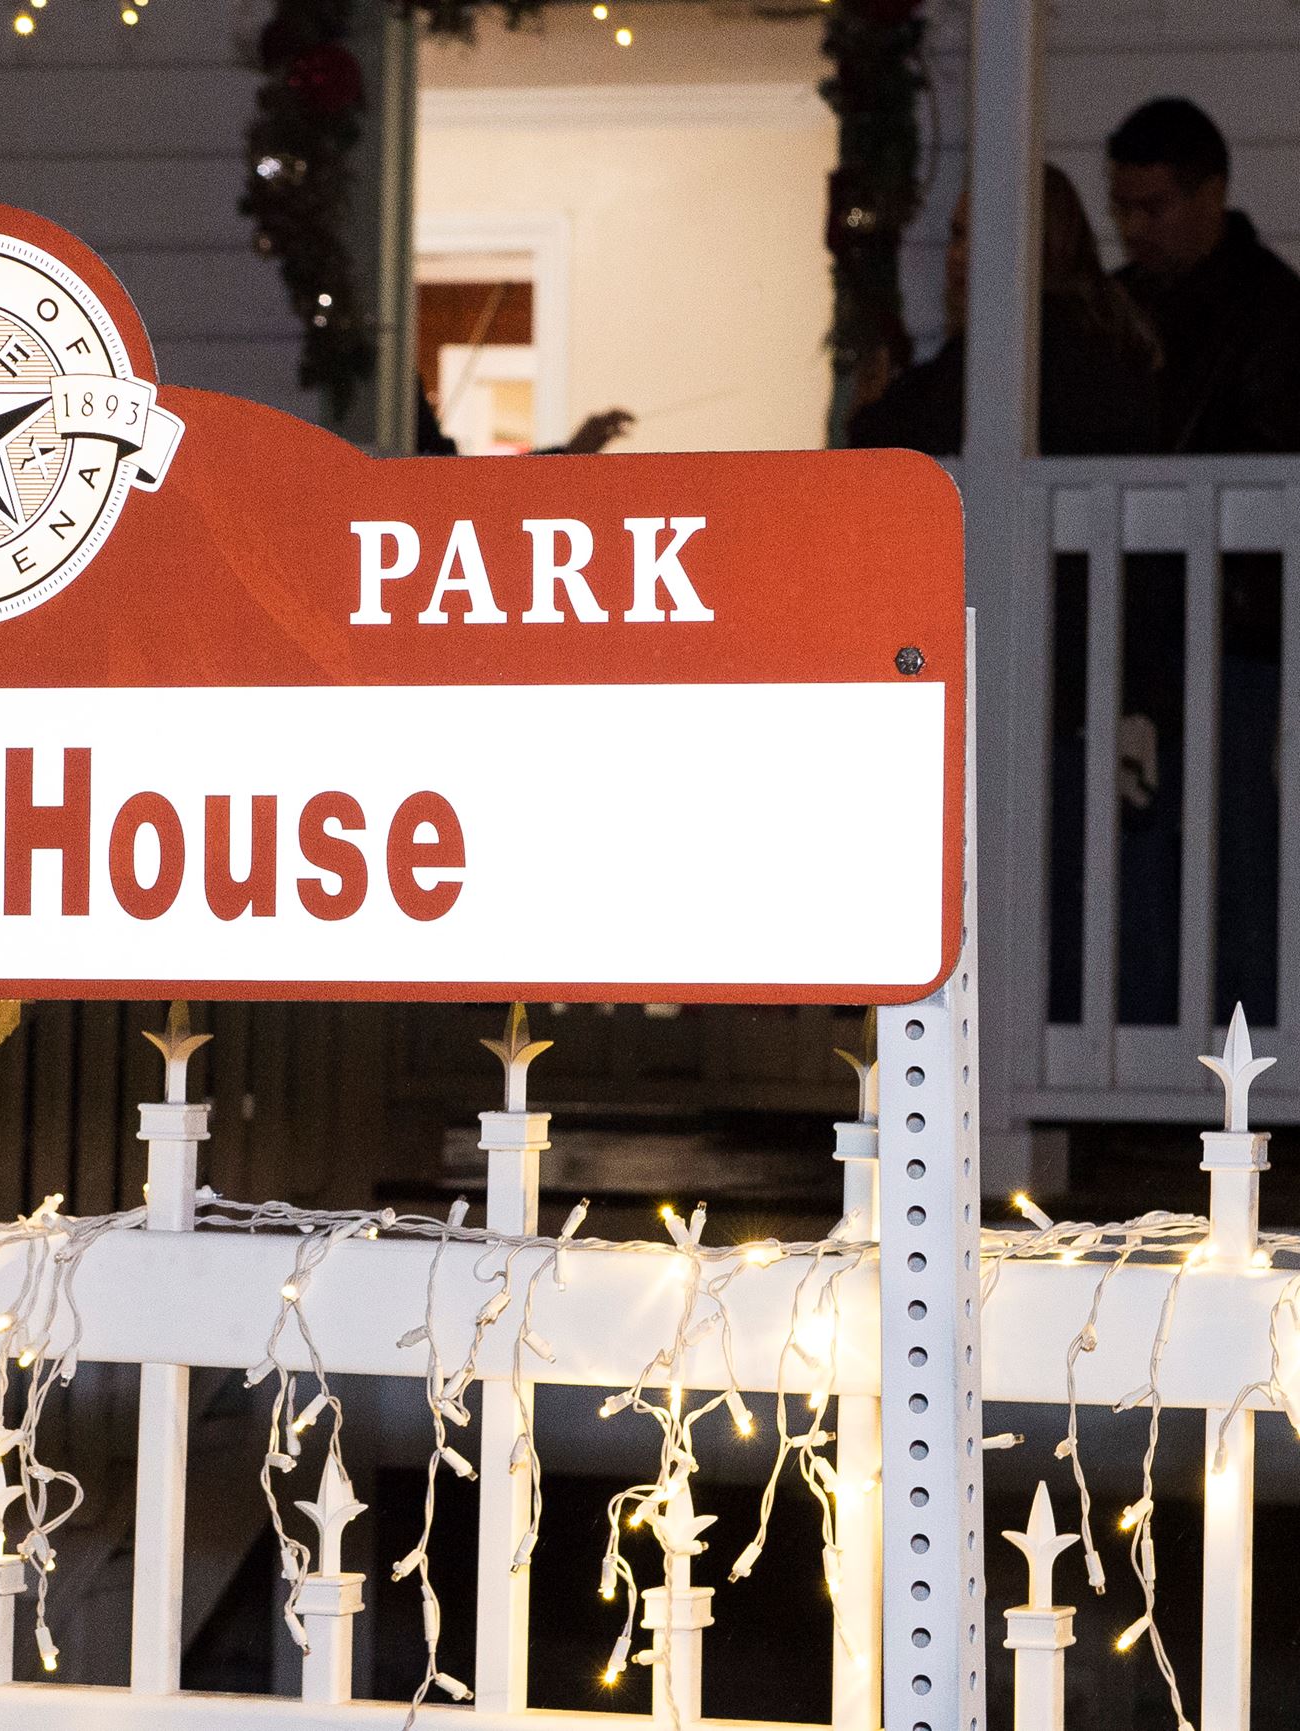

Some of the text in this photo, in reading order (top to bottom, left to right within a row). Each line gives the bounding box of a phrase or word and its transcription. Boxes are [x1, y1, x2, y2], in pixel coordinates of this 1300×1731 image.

[37, 298, 91, 356] OF
[63, 392, 141, 426] 1893
[349, 517, 715, 625] PARK
[3, 747, 466, 922] House
